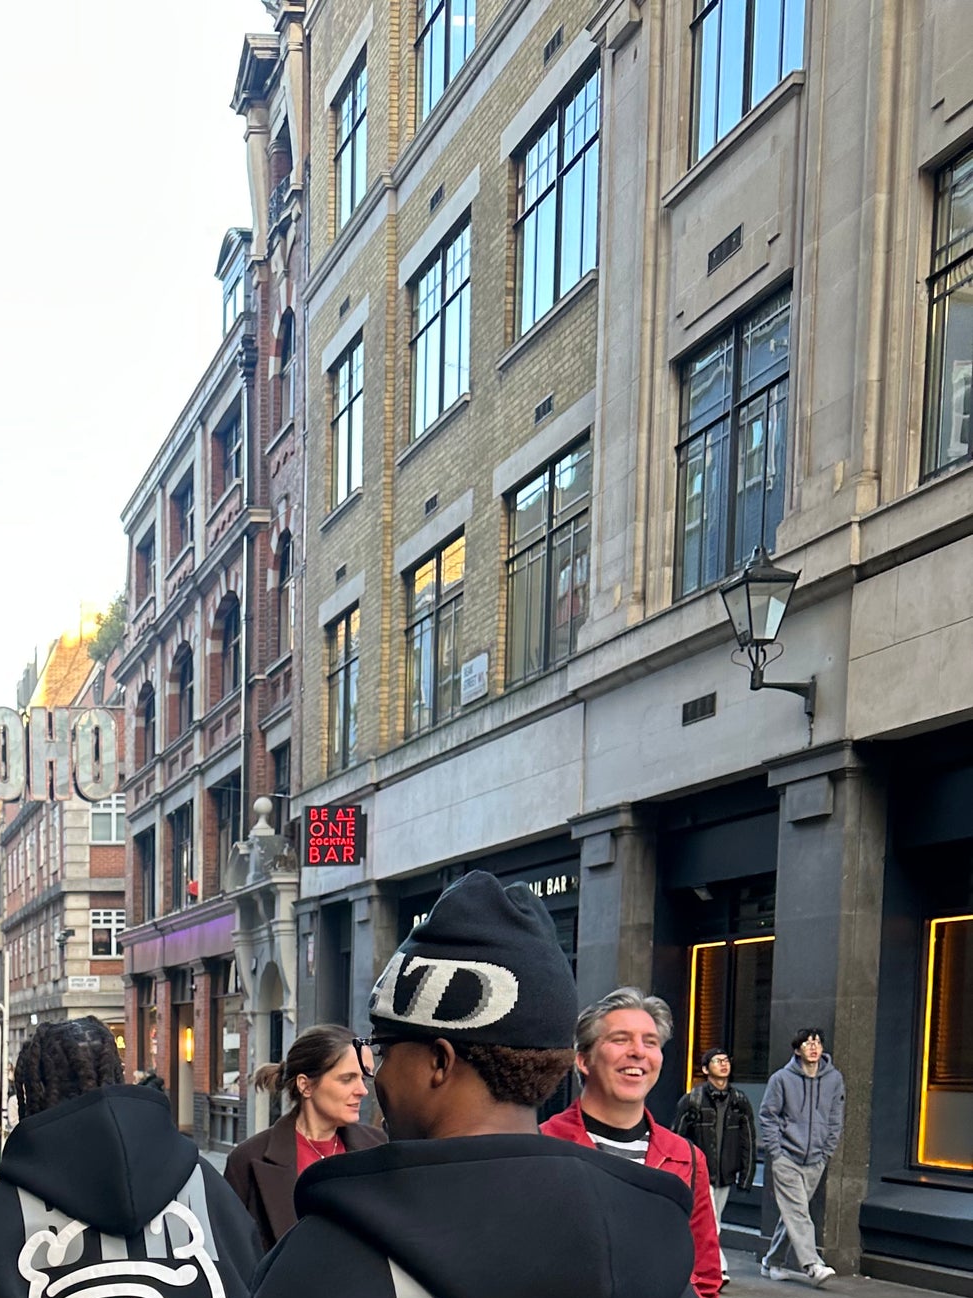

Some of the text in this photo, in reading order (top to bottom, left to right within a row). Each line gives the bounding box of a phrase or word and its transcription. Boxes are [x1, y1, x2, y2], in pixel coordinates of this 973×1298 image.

[310, 807, 355, 821] BE AT
[309, 821, 355, 837] ONE
[309, 837, 355, 846] COCKTAIL
[309, 846, 355, 864] BAR
[546, 875, 568, 896] BAR
